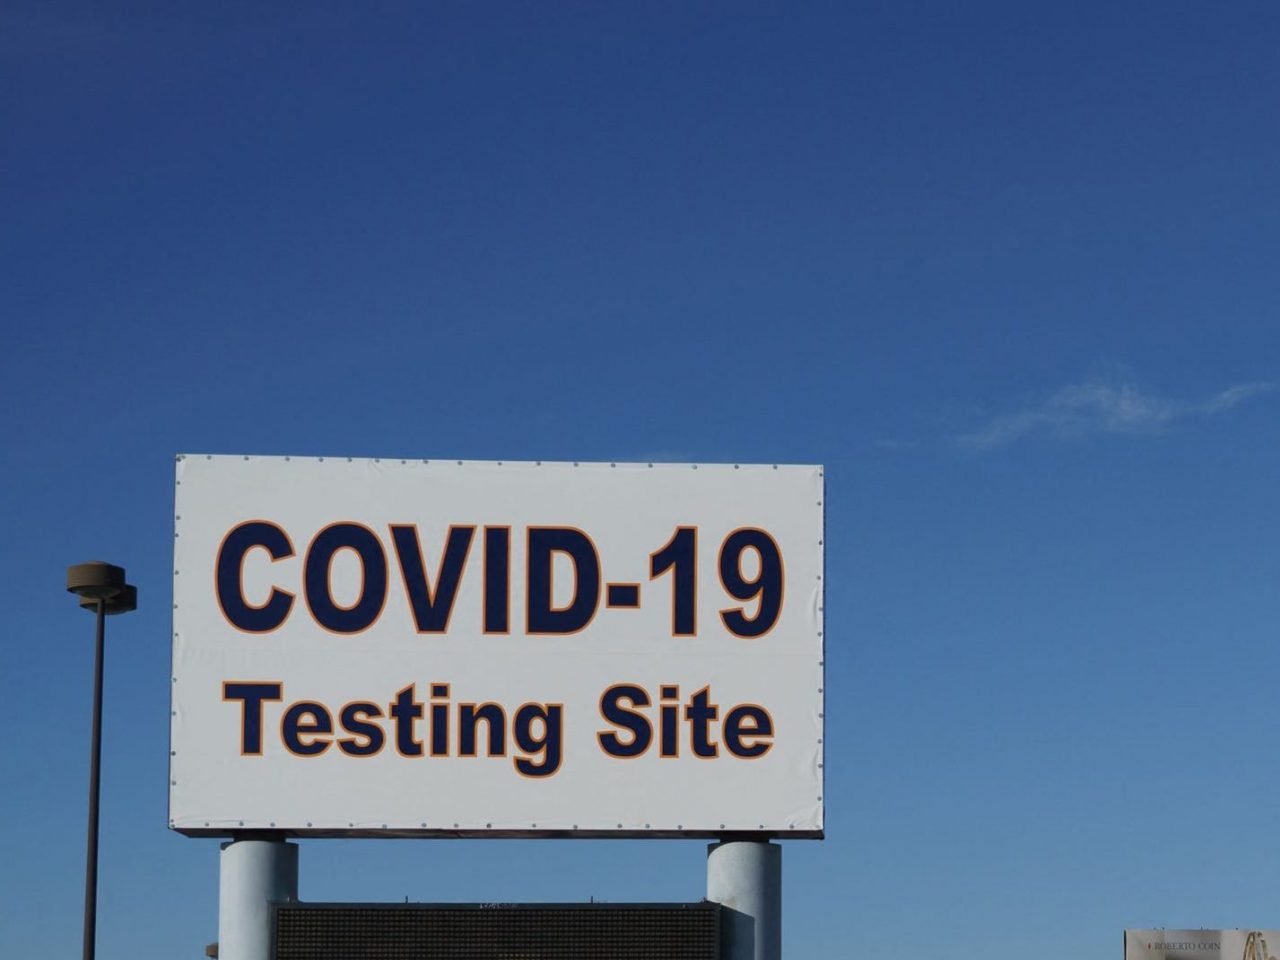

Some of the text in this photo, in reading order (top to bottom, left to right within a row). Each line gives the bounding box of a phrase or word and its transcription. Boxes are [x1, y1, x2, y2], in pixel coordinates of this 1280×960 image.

[214, 519, 785, 640] COVID-19
[222, 681, 776, 779] Testing Site
[1154, 941, 1221, 951] ROBERTO COIN
